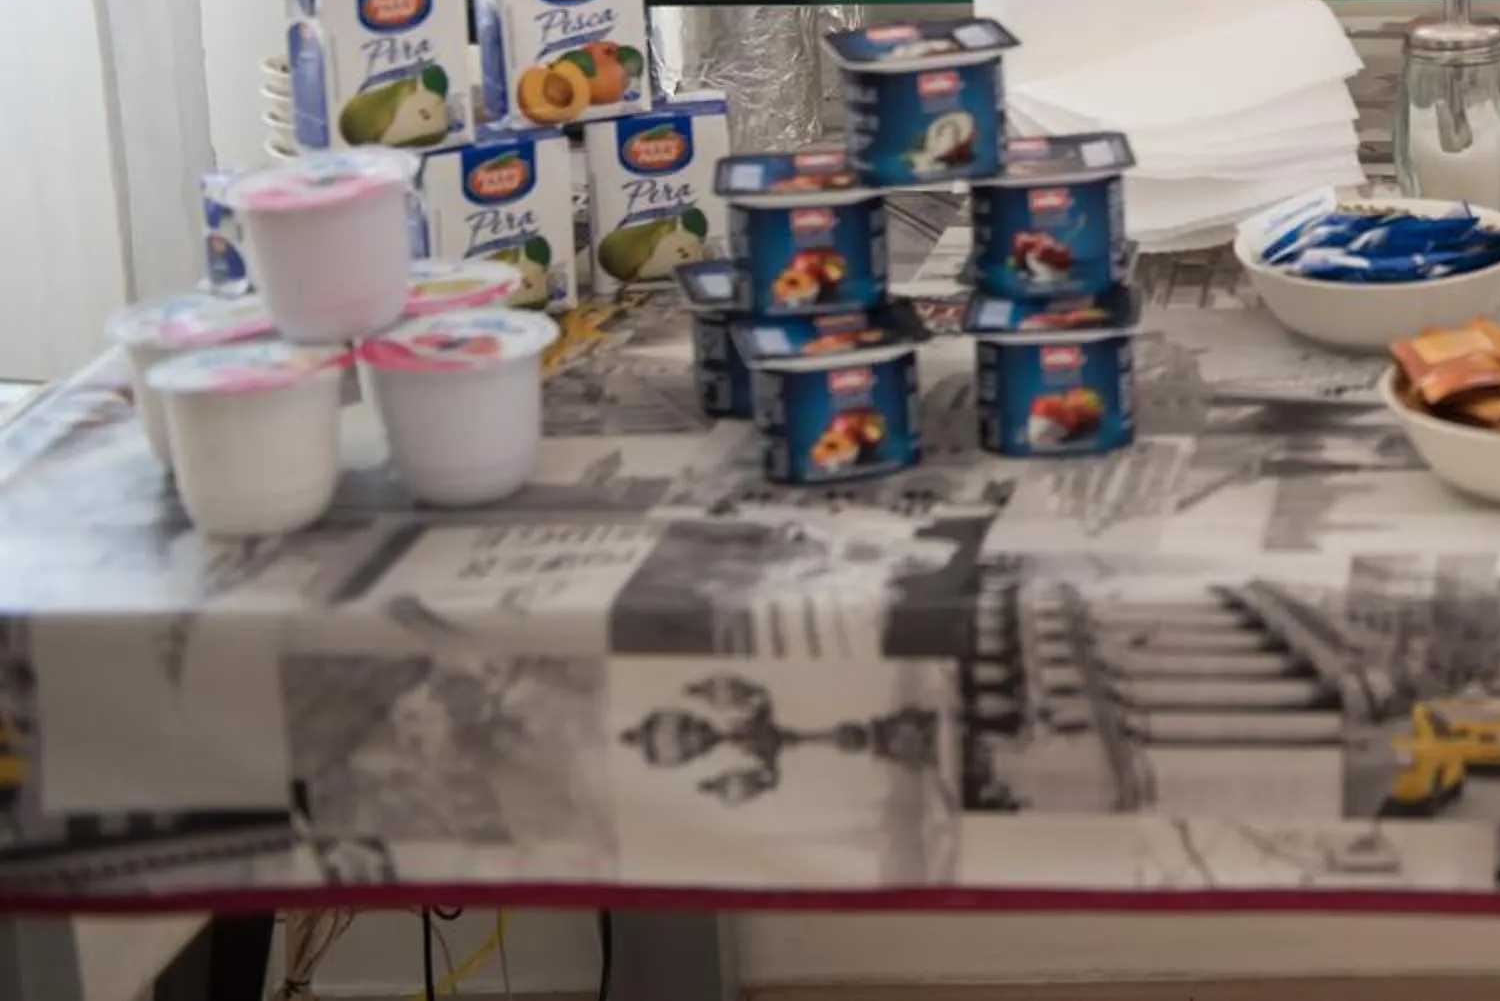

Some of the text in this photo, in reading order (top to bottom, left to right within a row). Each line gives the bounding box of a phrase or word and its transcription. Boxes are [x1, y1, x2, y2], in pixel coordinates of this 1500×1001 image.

[534, 5, 619, 41] Pesca
[623, 178, 696, 212] Pera
[464, 207, 537, 242] Pera
